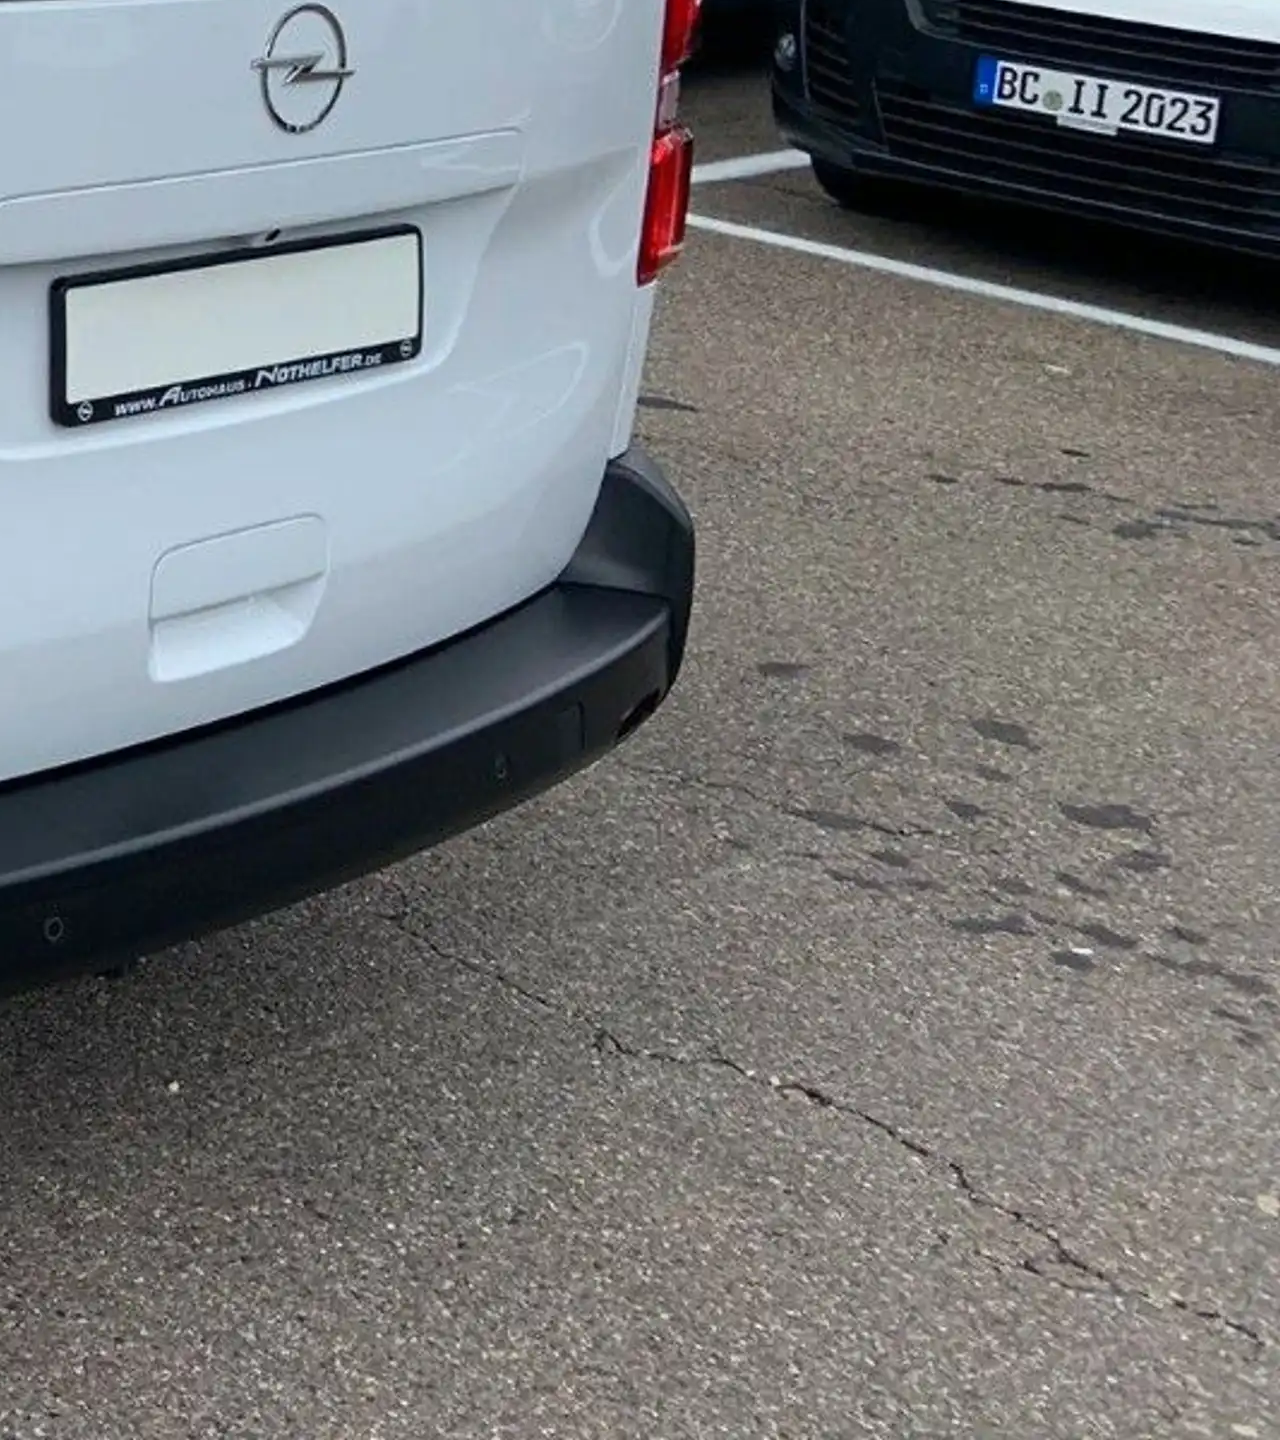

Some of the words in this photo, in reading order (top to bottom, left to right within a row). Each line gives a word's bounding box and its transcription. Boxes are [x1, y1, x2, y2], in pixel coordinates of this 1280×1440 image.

[996, 67, 1040, 105] BC
[1068, 79, 1110, 119] II
[1119, 89, 1216, 136] 2023
